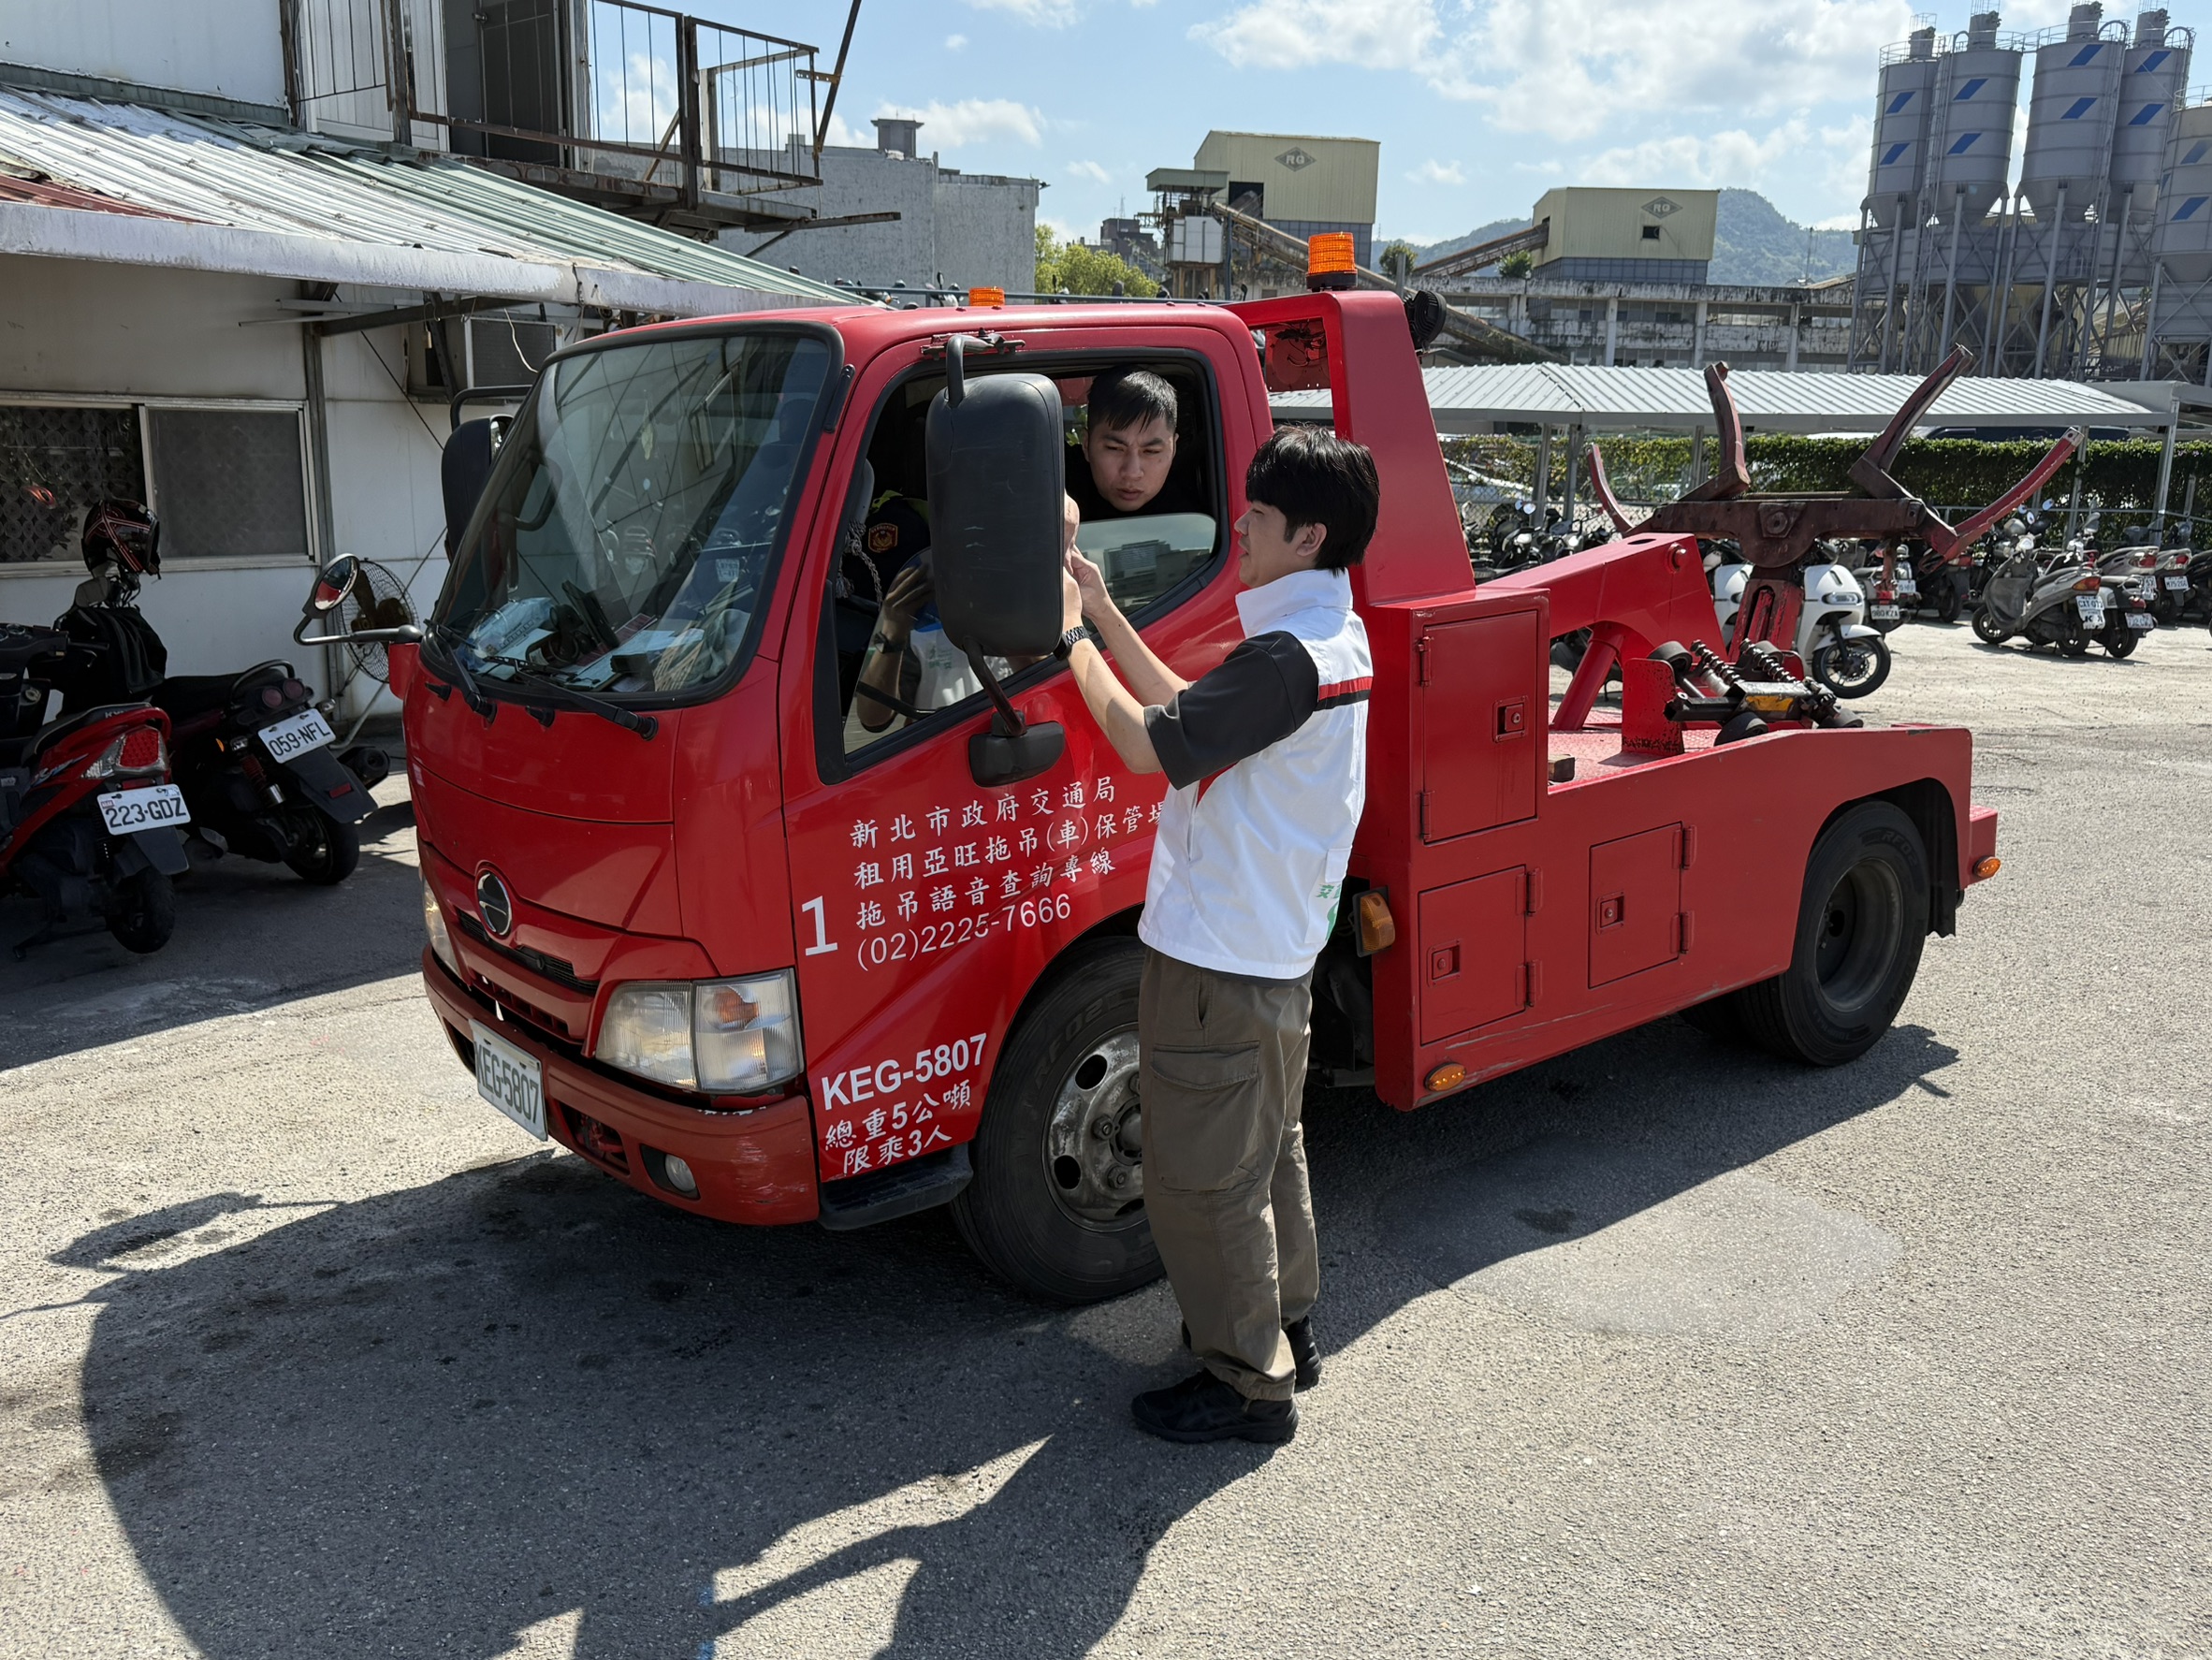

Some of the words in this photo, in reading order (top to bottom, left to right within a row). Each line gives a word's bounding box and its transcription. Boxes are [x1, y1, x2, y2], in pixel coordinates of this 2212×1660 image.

[850, 776, 1115, 849] 新北市政府交通局
[856, 847, 1115, 930] 拖吊語音查詢專線
[801, 896, 837, 956] 1
[857, 893, 1071, 971] (02)2225-7666
[821, 1033, 987, 1111] KEG-5807
[825, 1079, 971, 1151] 總重5公噸
[843, 1124, 953, 1174] 限乘3人
